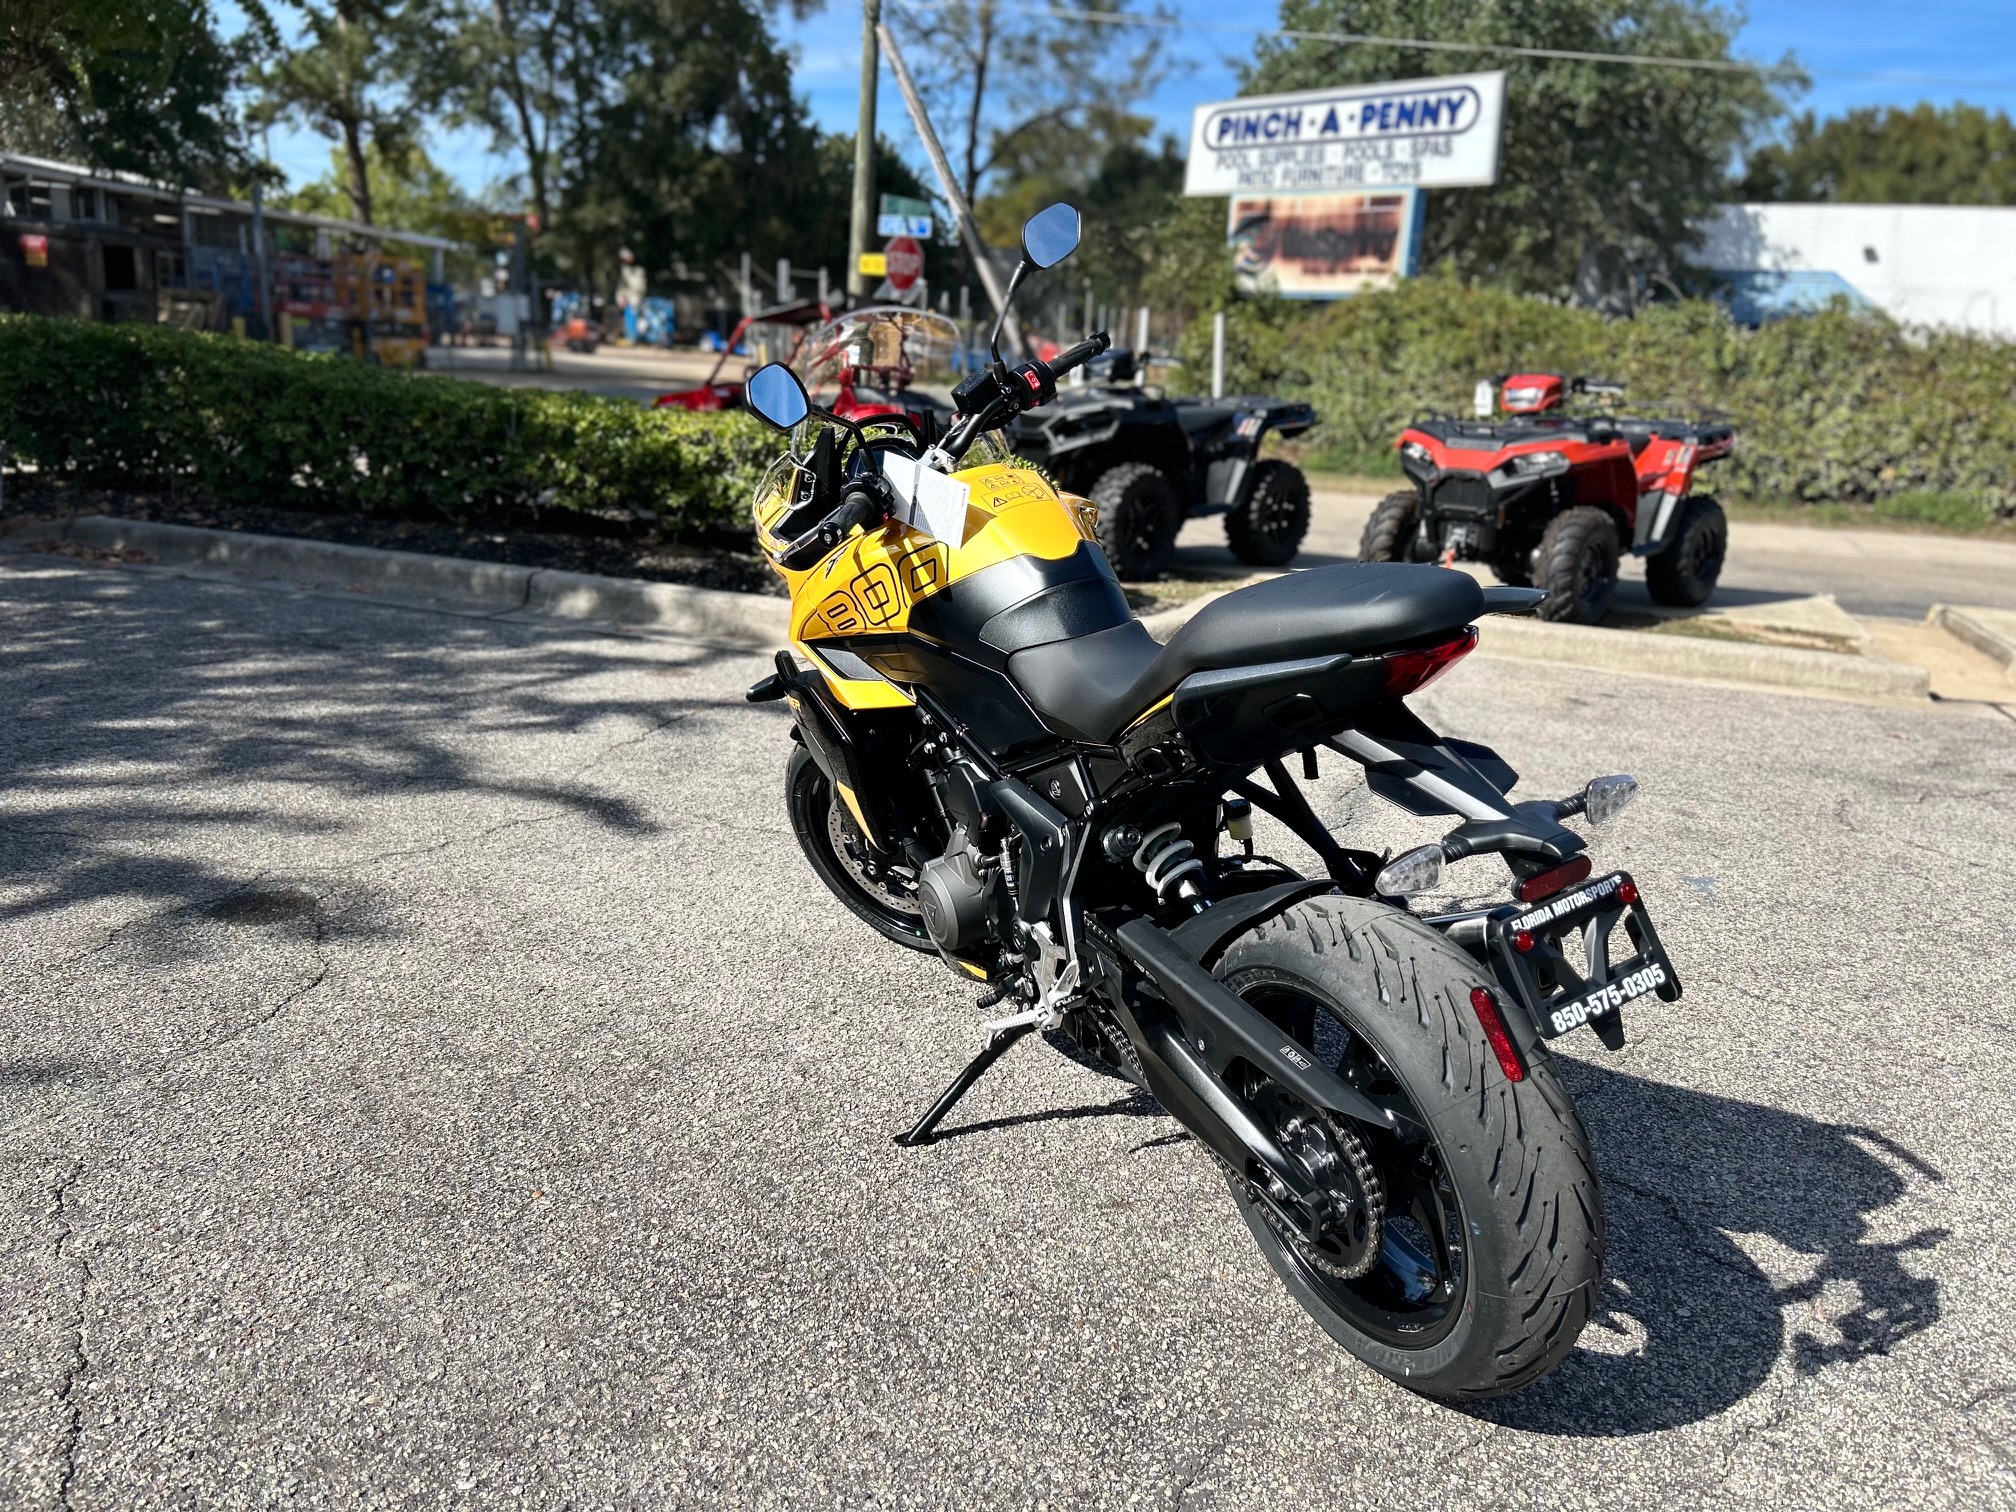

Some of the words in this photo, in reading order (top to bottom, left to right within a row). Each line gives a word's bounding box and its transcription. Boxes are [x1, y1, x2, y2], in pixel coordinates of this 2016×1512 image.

[1217, 111, 1303, 143] PINCH
[1320, 107, 1340, 134] A
[1359, 95, 1467, 131] PENNY
[1511, 908, 1554, 932] FLORIDA
[1553, 874, 1622, 918] MOTORSPORTS
[1551, 962, 1666, 1033] 850-575-0305
